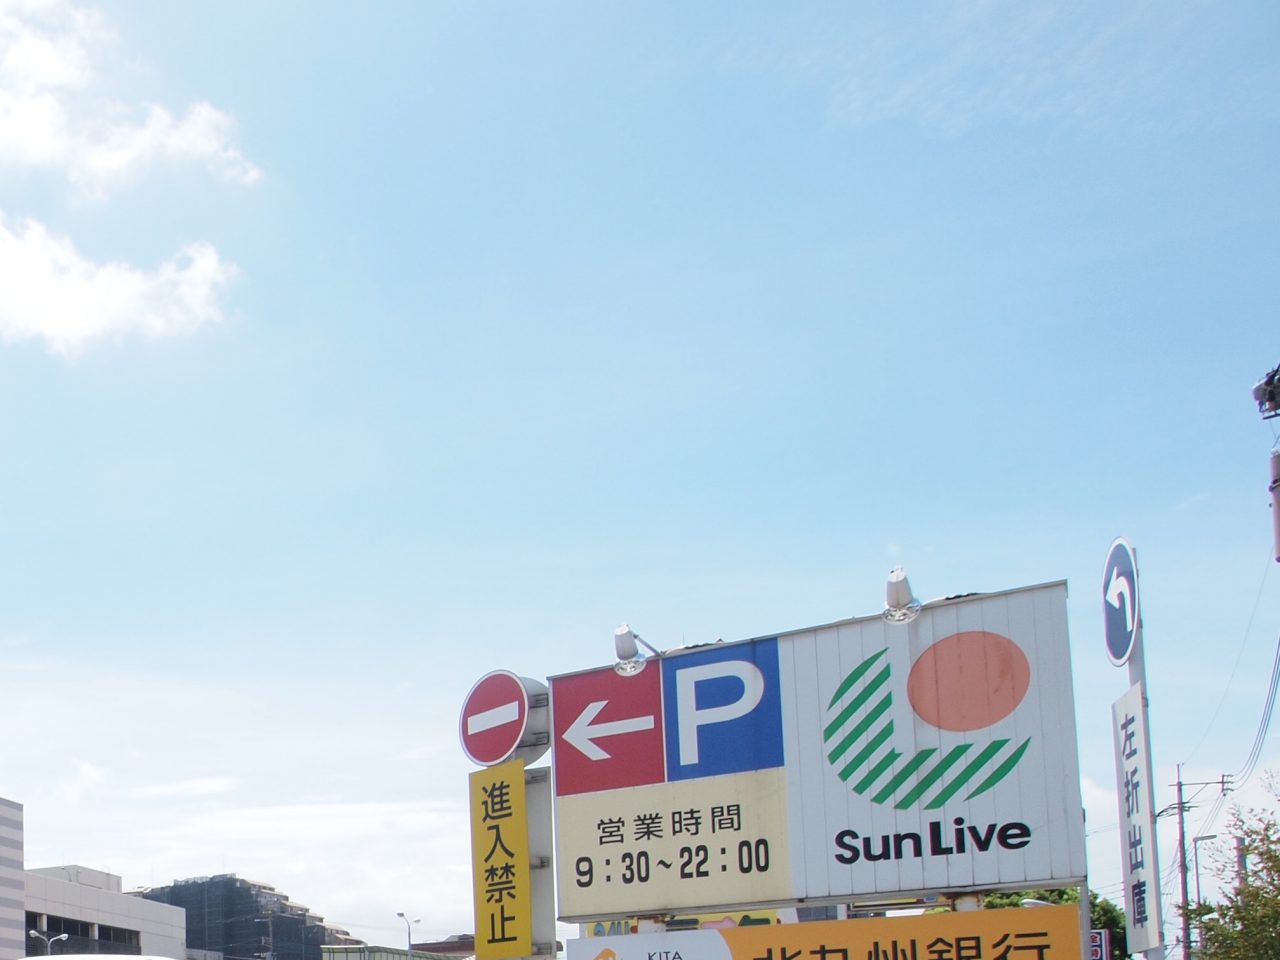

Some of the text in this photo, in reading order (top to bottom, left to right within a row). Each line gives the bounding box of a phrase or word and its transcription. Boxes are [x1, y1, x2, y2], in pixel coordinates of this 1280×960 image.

[676, 660, 764, 766] P
[481, 780, 518, 944] 進入禁止
[597, 804, 741, 846] 営業時間
[1121, 713, 1148, 929] 左折出庫
